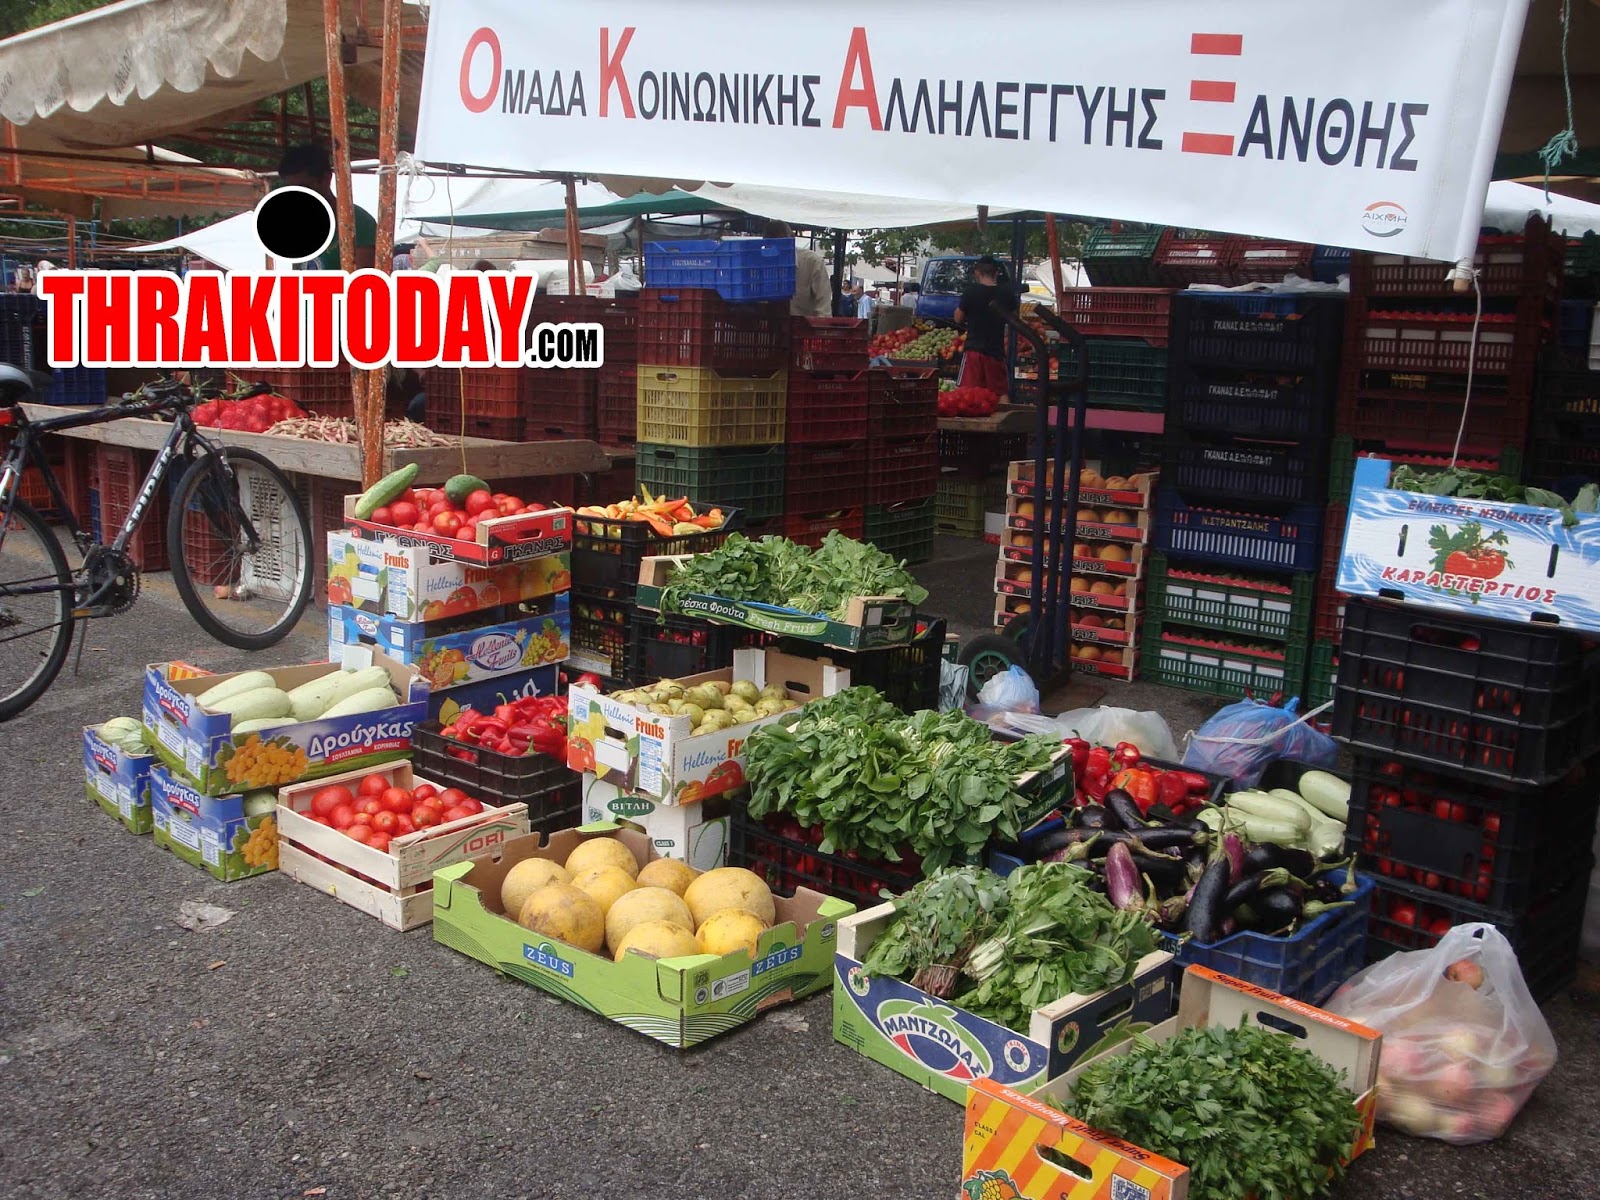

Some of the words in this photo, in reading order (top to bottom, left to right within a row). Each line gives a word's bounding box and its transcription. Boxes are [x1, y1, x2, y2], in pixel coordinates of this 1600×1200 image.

[459, 27, 587, 116] ΟΜΑΔΑ
[599, 27, 821, 128] ΚΟΙΝΩΝΙΚΗΣ
[832, 27, 1166, 150] ΑΛΛΗΛΕΓΓΥΗΣ
[1181, 33, 1429, 171] ΞΑΝΘΗΣ
[1408, 500, 1473, 517] ΕΚΛΕΚΤΕΣ
[1479, 508, 1553, 526] ΝΤΟΜΑΤΕΣ
[357, 543, 383, 560] Hellenic
[384, 552, 410, 569] Fruits
[504, 536, 565, 559] ΓΚΑΝΑΣ
[426, 576, 464, 592] Hellenic
[1381, 566, 1557, 604] ΚΑΡΑΣΤΕΡΓΙΟΣ
[679, 598, 708, 611] ρέσκα
[710, 600, 745, 619] Φρούτα
[749, 613, 781, 629] Fresh
[784, 620, 817, 634] Fruit
[604, 703, 635, 725] Hellenic
[635, 717, 664, 740] Fruits
[309, 721, 414, 758] Δρούγκας
[683, 751, 726, 772] Hellenic
[527, 947, 570, 974] ZEUS
[755, 947, 799, 974] ZEUS
[1213, 974, 1249, 989] Super
[884, 1016, 986, 1078] ΜΑΝΤΖΩΛΑΣ
[974, 1121, 993, 1134] CLASS
[1072, 1123, 1108, 1141] Fruit
[1108, 1136, 1151, 1161] Super
